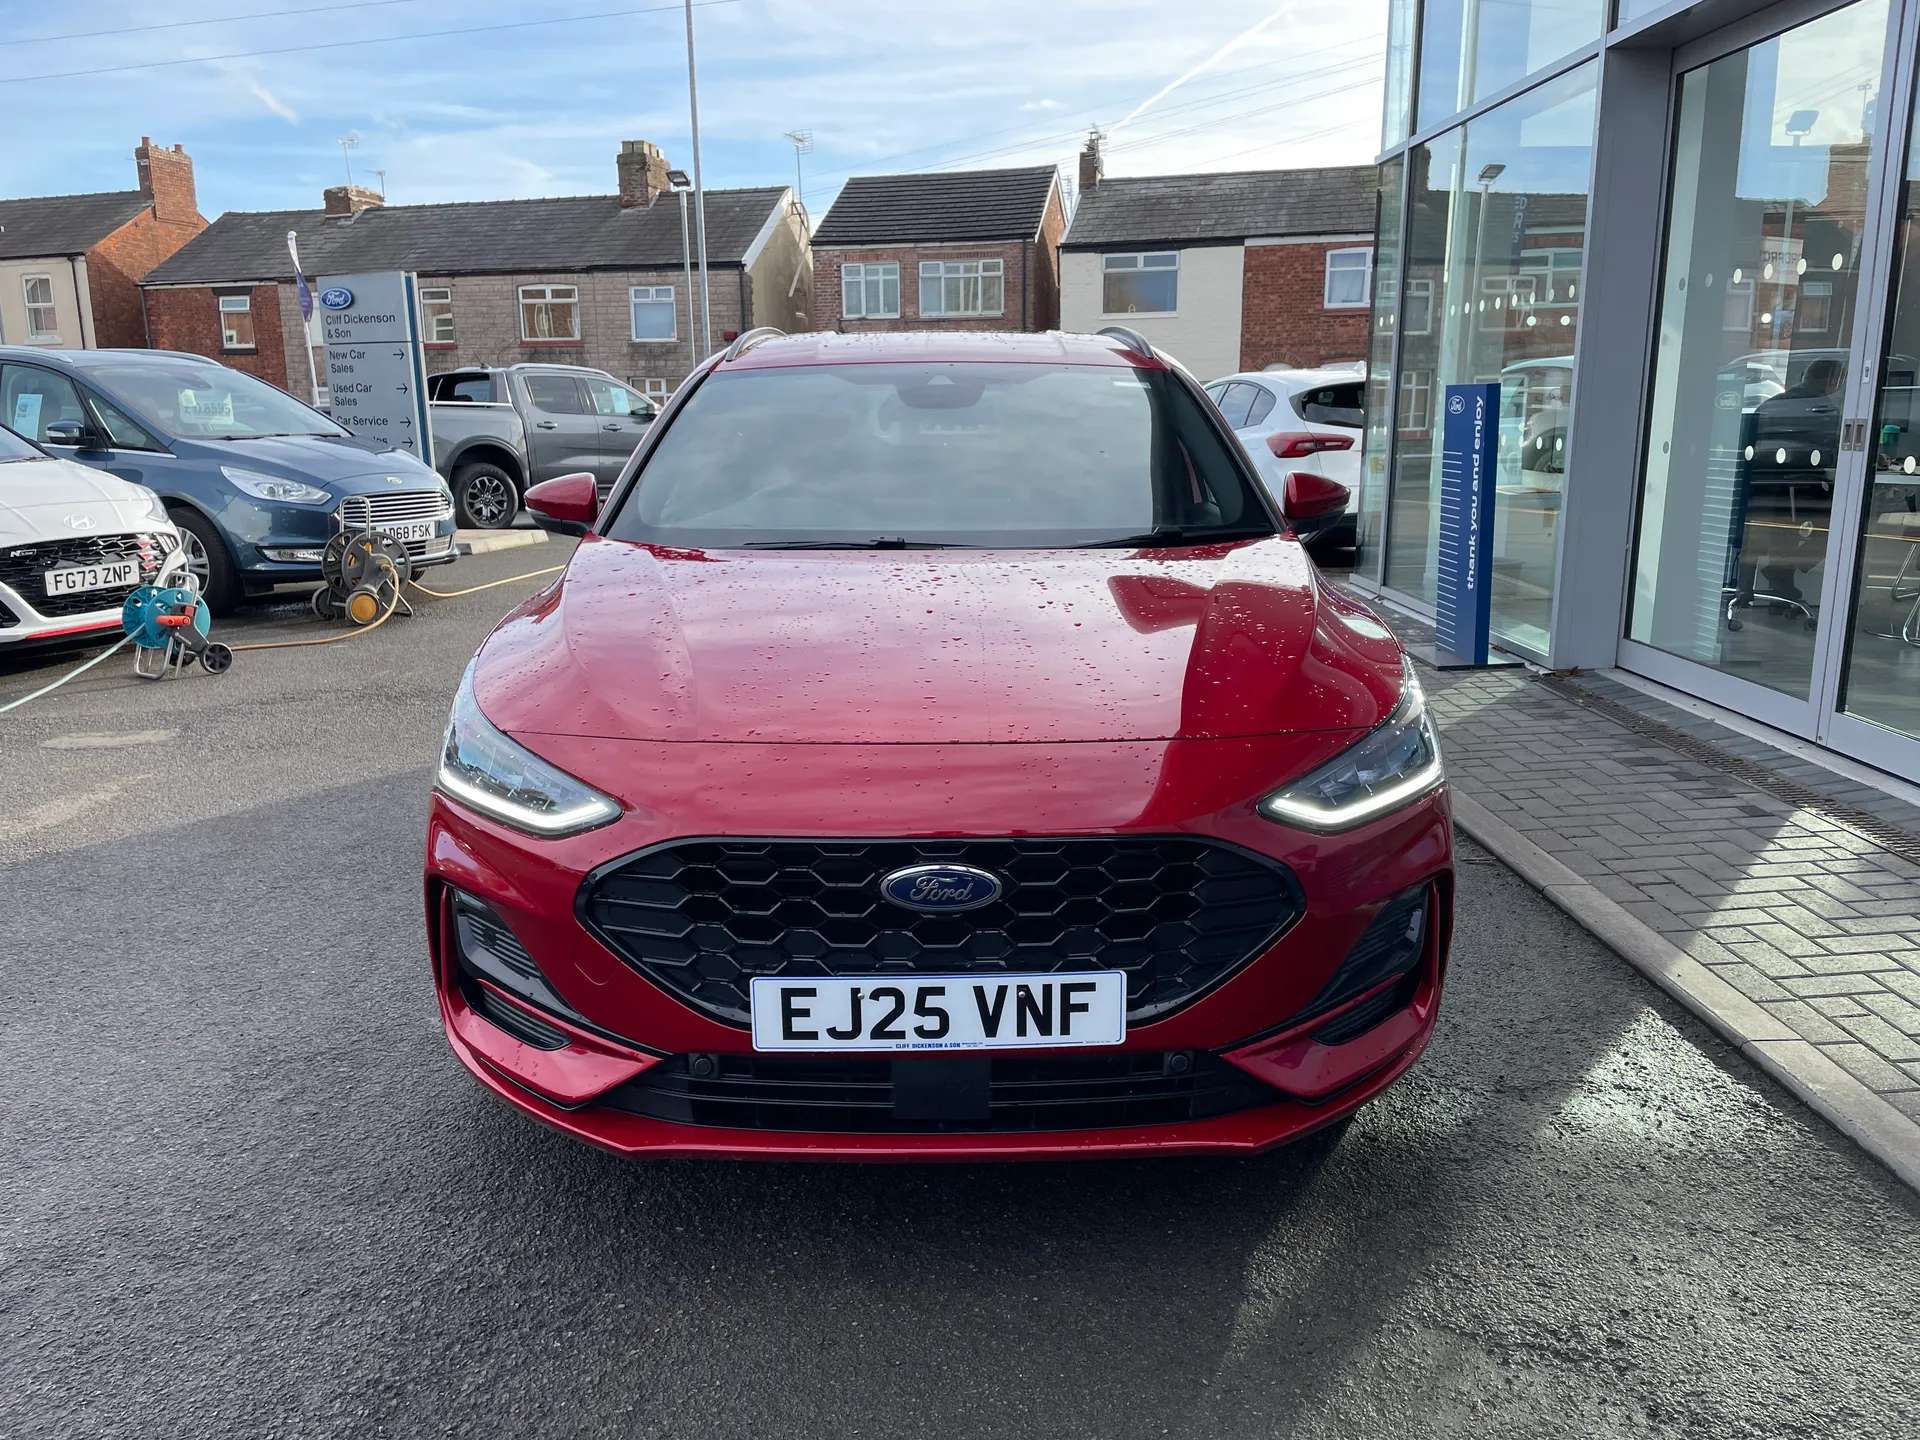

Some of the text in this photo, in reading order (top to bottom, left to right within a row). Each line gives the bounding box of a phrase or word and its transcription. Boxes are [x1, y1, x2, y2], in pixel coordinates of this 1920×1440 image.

[325, 291, 346, 305] Ford
[325, 314, 396, 326] Cliff Dickenson
[327, 328, 352, 338] & Son
[329, 349, 366, 360] New Car
[331, 363, 354, 374] Sales
[333, 382, 373, 393] Used Car
[334, 396, 358, 407] Sales
[352, 415, 389, 426] Service
[1467, 396, 1484, 591] thank you and enjoy
[412, 524, 431, 539] FSK
[53, 564, 132, 591] FG73 ZNP
[910, 876, 974, 901] Ford
[780, 981, 1097, 1041] EJ25 VNF
